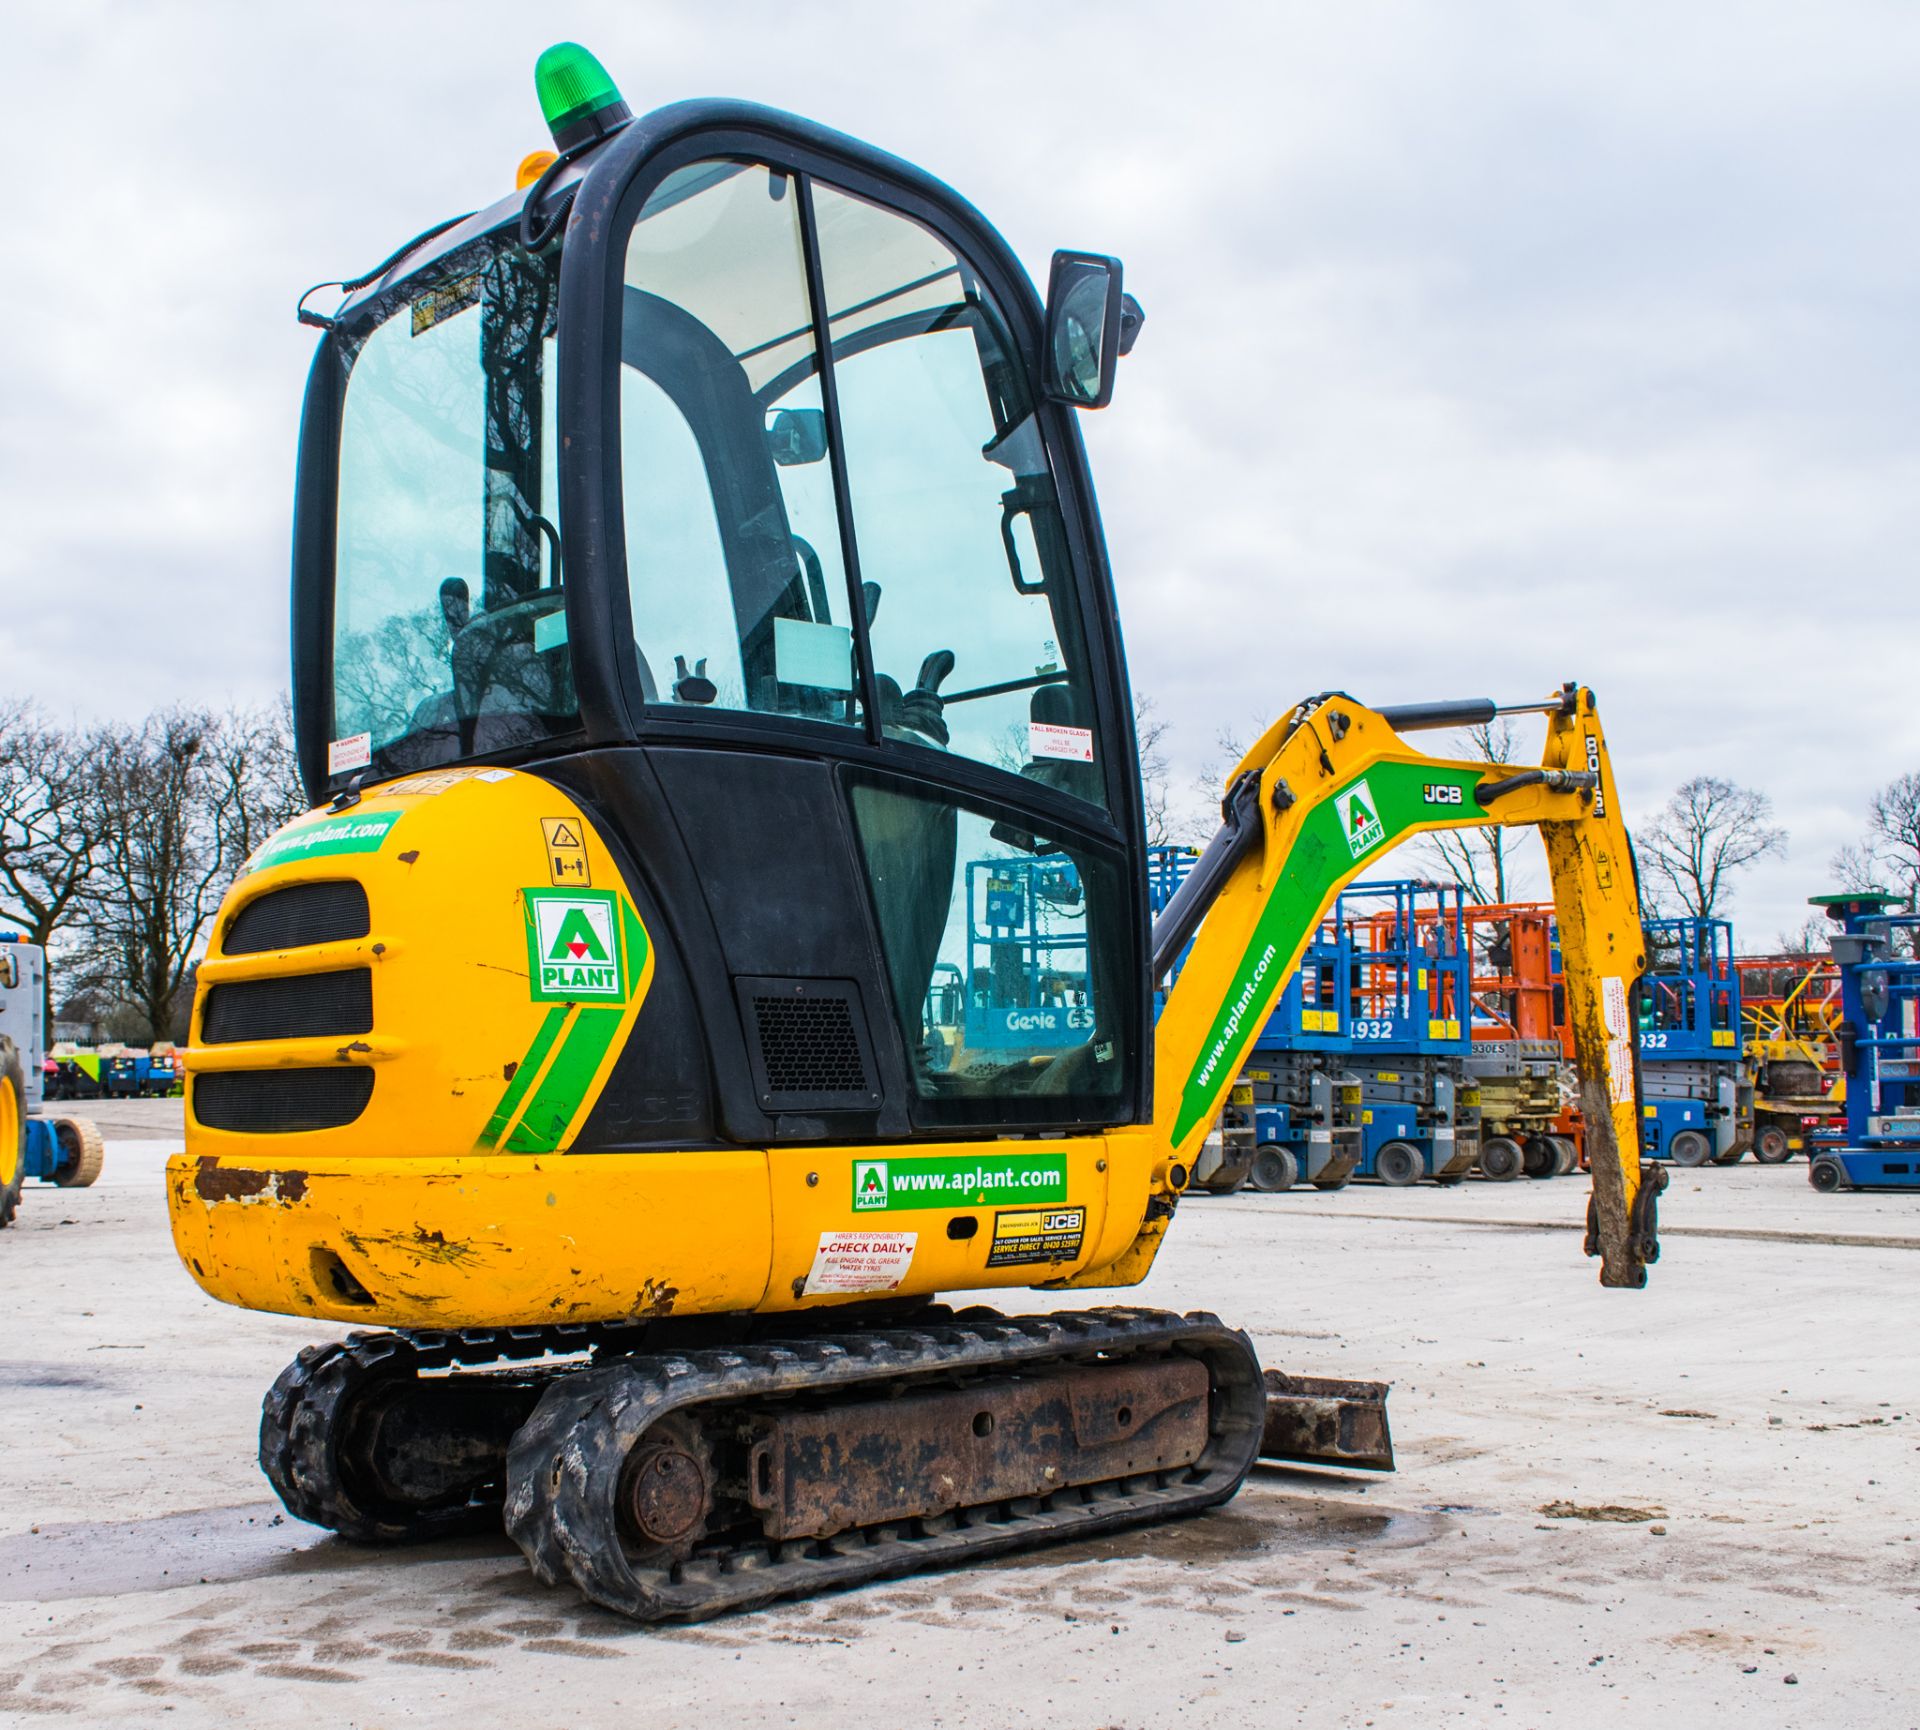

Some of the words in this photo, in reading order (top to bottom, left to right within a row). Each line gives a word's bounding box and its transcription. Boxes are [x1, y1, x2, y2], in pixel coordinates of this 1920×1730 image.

[1046, 727, 1068, 735] BROKEN
[1044, 745, 1068, 753] CHARGED
[1424, 785, 1462, 803] JCB
[1349, 793, 1375, 836] A
[268, 822, 390, 855] www.aplant.com
[1350, 823, 1382, 853] PLANT
[548, 909, 610, 960] A
[543, 967, 615, 988] PLANT
[1006, 1011, 1056, 1031] Genie
[1197, 943, 1277, 1088] www.aplant.com
[860, 1167, 885, 1193] A
[892, 1167, 1061, 1195] www.aplant.com
[857, 1196, 887, 1206] PLANT
[1044, 1214, 1080, 1230] JCB
[835, 1232, 857, 1240] HIRER'S
[858, 1232, 904, 1240] RESPONSIBILITY
[829, 1243, 870, 1253] CHECK
[872, 1243, 906, 1253] DAILY
[993, 1245, 1018, 1254] SERVICE
[1019, 1243, 1040, 1251] DIRECT
